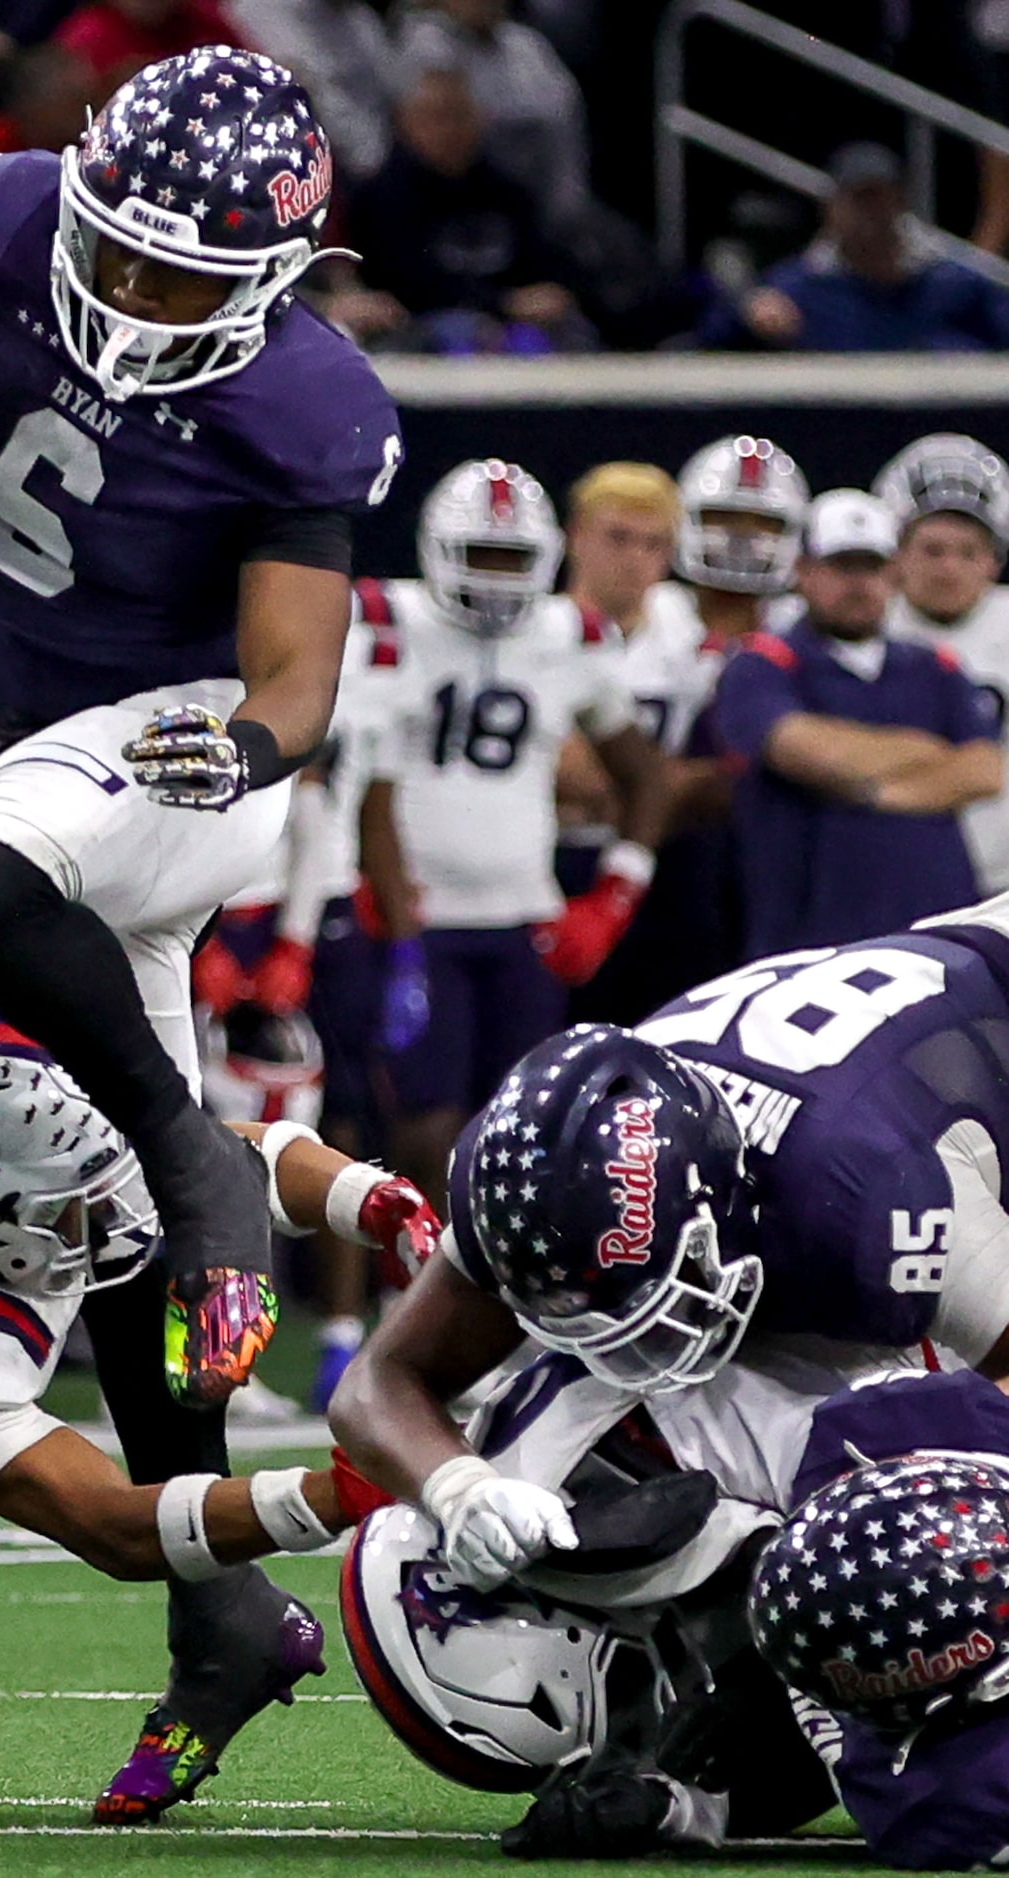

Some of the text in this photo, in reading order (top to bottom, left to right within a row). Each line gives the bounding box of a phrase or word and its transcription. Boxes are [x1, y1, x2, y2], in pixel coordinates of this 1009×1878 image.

[132, 207, 178, 235] BLUE
[267, 145, 333, 228] Raid
[50, 376, 123, 439] RYAN
[433, 682, 530, 770] 18
[598, 1099, 657, 1269] Raiders
[889, 1207, 954, 1293] 85
[821, 1629, 995, 1699] Raiders
